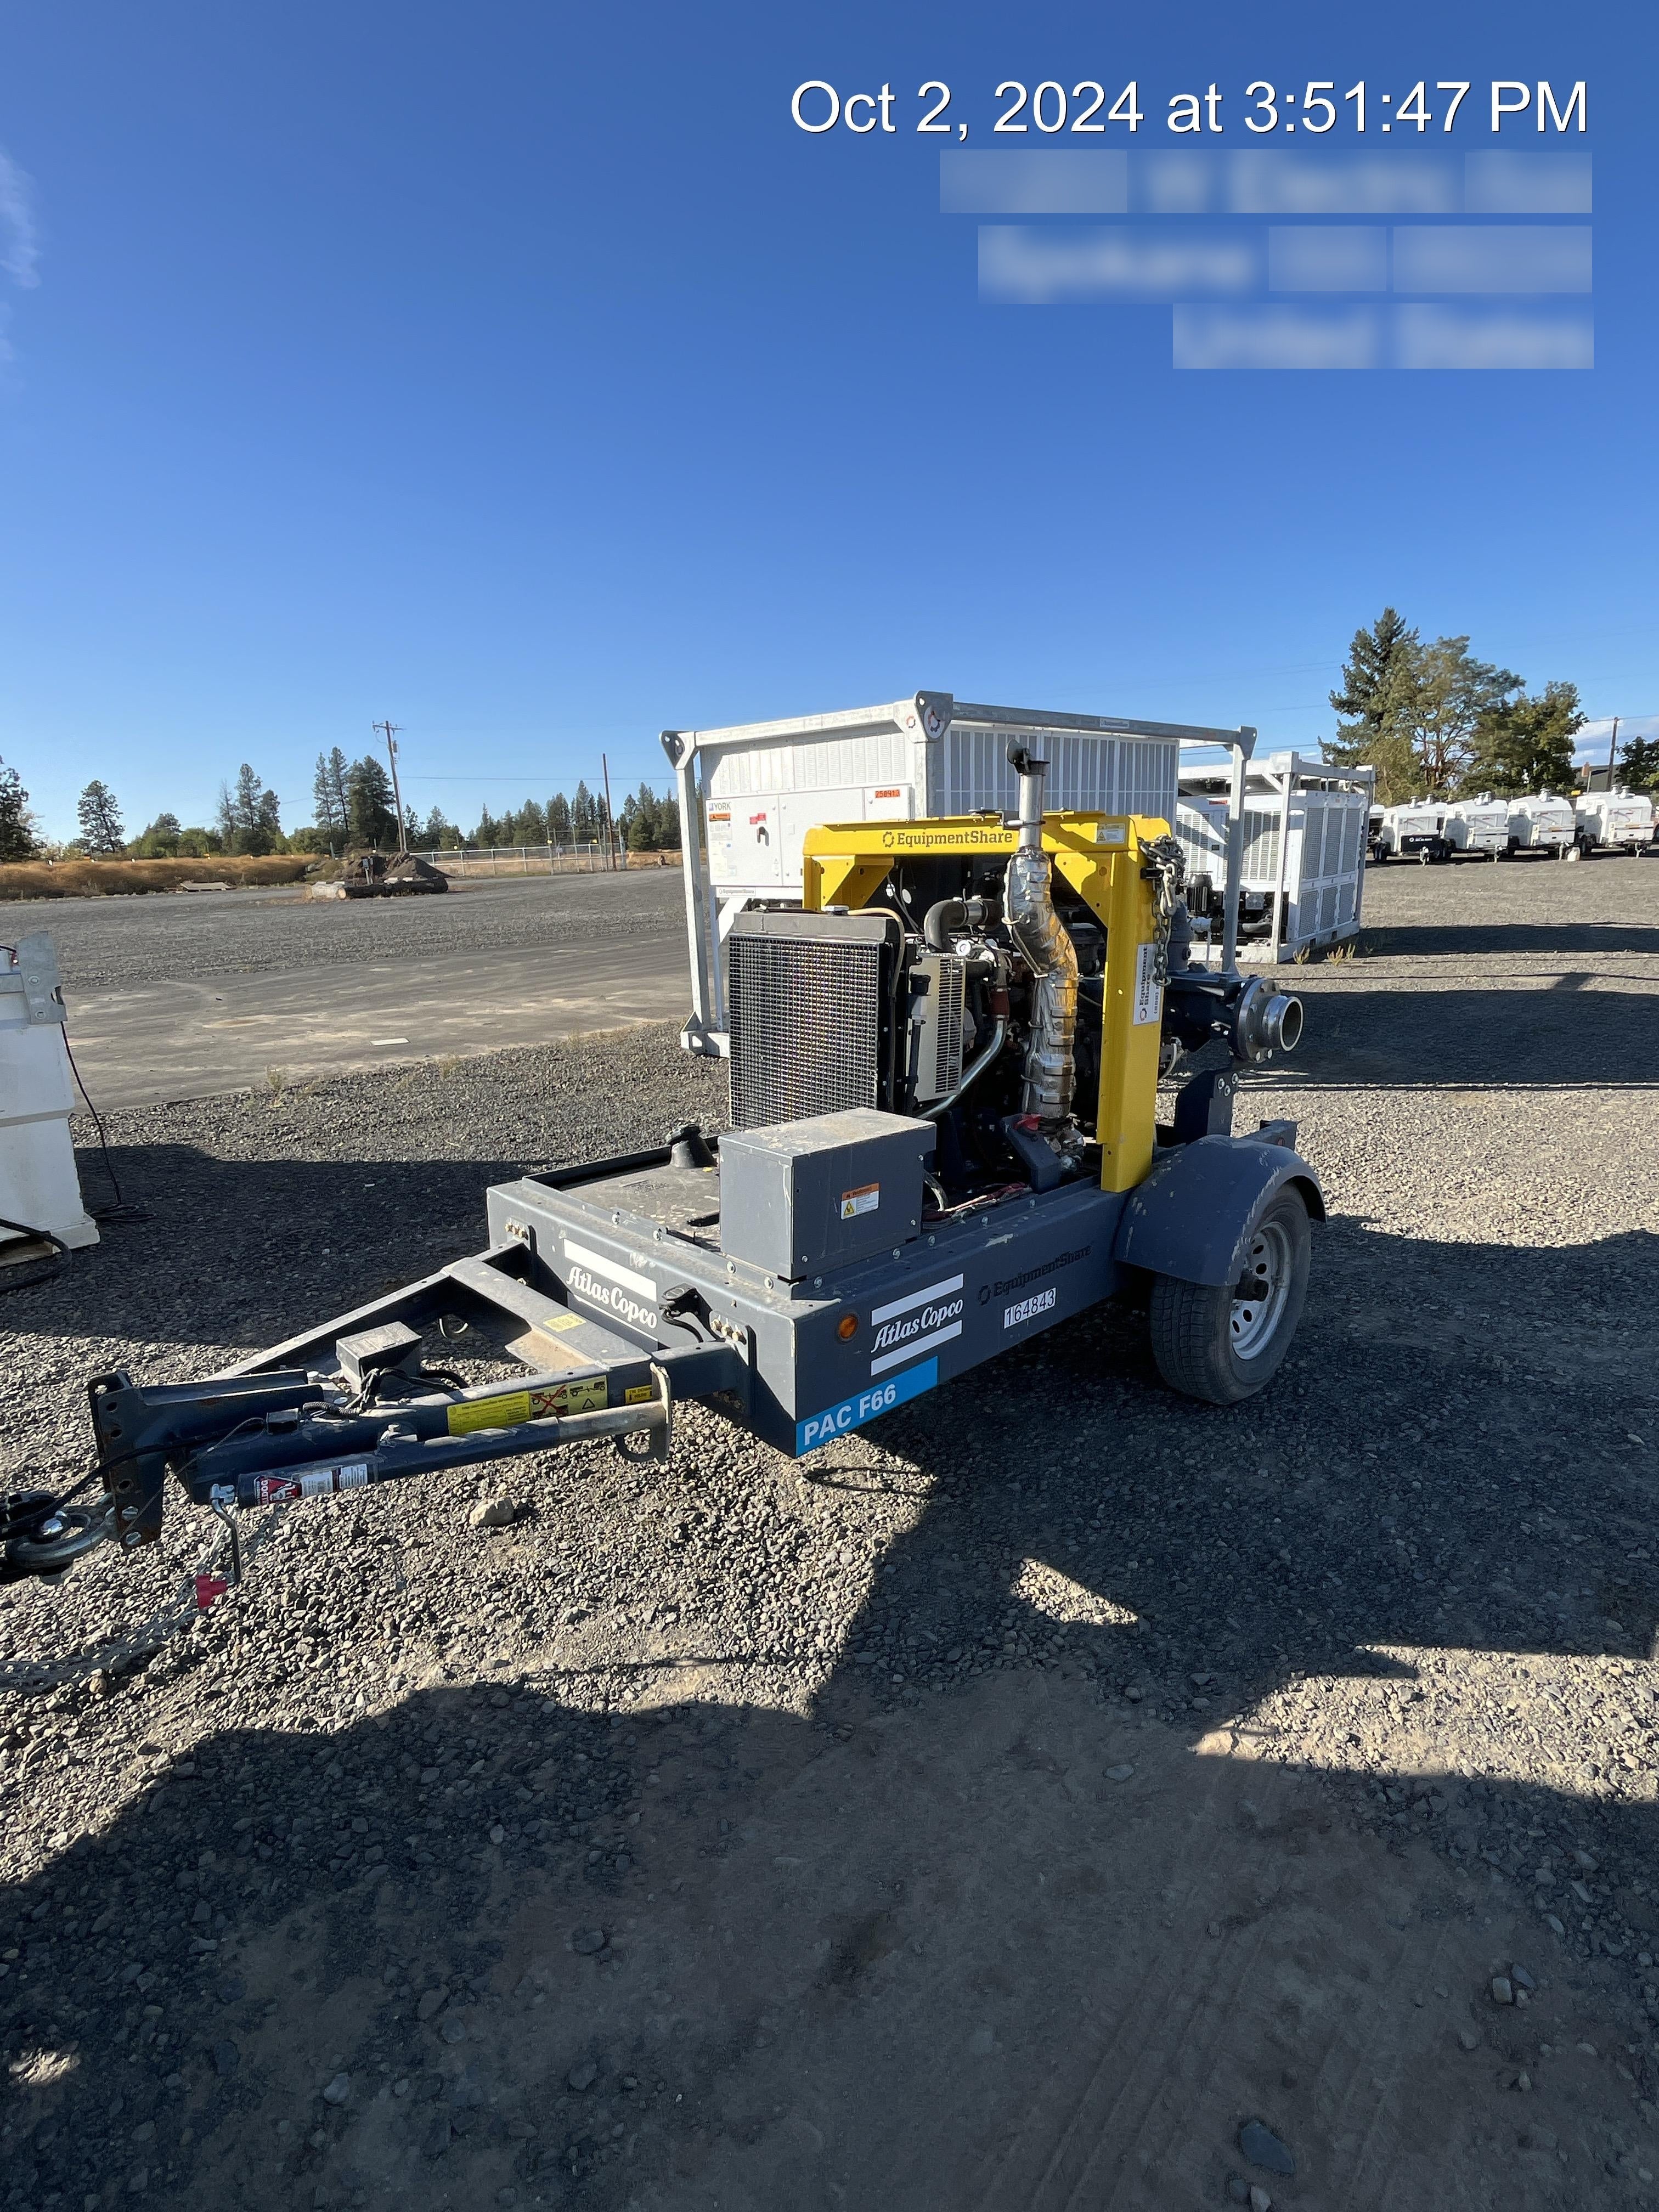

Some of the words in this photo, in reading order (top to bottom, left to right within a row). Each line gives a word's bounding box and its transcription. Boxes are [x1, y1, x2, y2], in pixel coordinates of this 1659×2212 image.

[714, 802, 731, 811] YORK
[897, 830, 1013, 848] EquipmentShare
[1139, 946, 1148, 1006] Equipment
[566, 1266, 610, 1305] Atlas
[610, 1286, 657, 1329] Copco
[994, 1245, 1092, 1297] EquipmentShare
[870, 1318, 920, 1353] Atlas
[921, 1299, 963, 1328] Copco
[1006, 1289, 1054, 1325] 164843
[804, 1405, 851, 1446] PAC
[859, 1384, 896, 1419] F66
